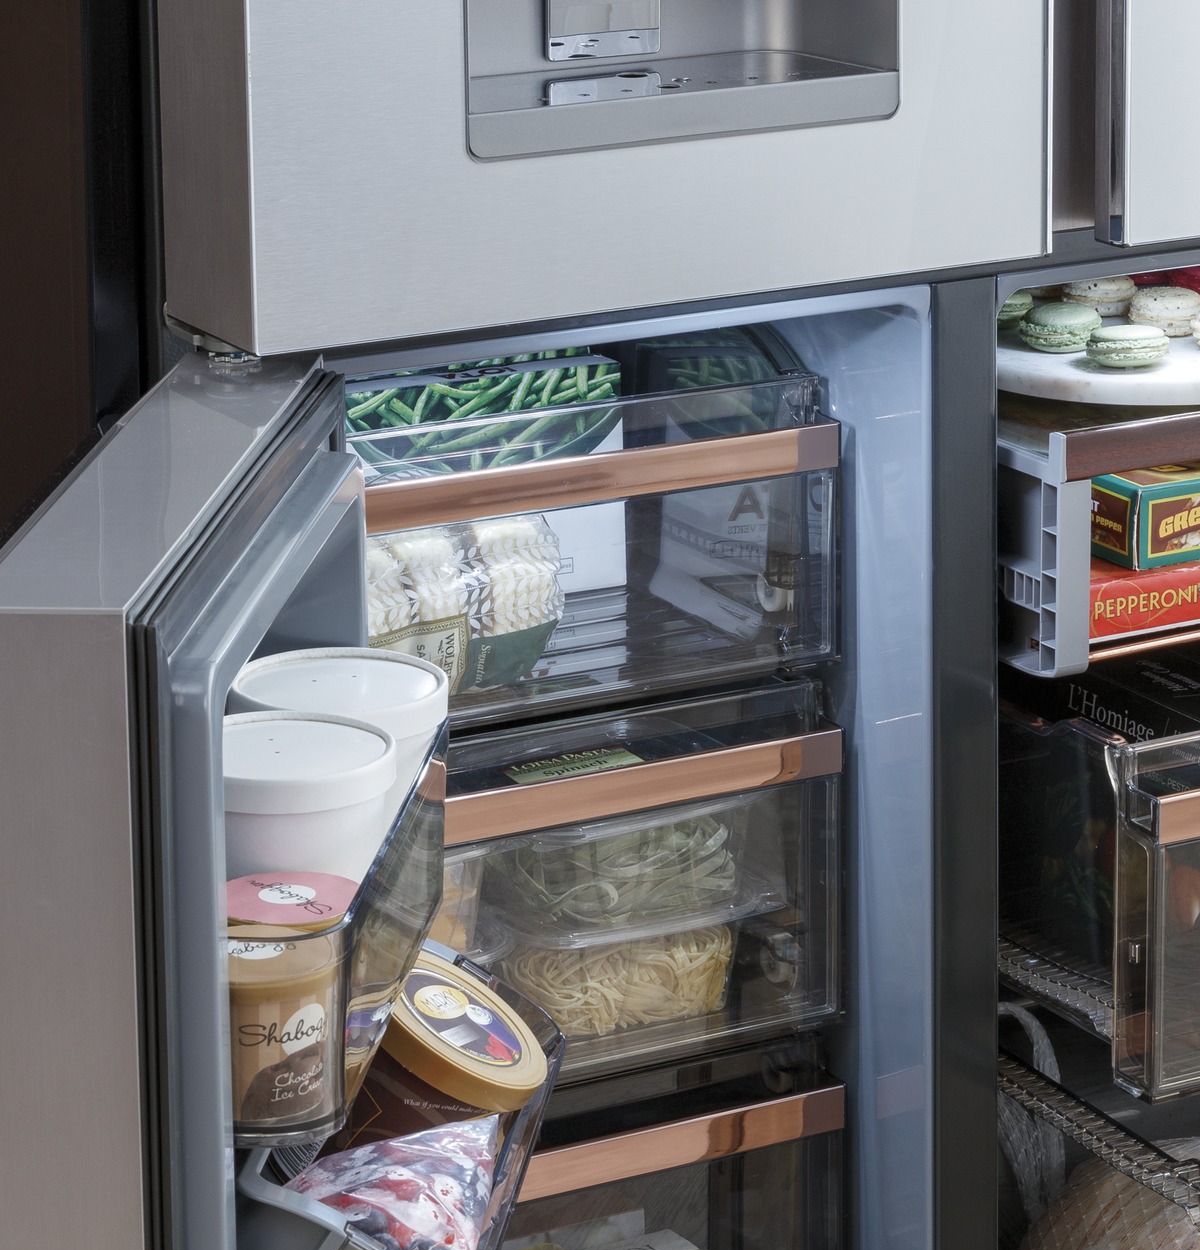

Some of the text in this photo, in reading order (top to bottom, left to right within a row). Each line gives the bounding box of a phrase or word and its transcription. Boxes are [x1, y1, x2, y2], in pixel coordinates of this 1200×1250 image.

[1094, 585, 1199, 620] PEPPERONI
[1067, 683, 1155, 744] L'Homiage
[543, 759, 609, 777] Spinach
[270, 1087, 295, 1102] Ice
[403, 1099, 421, 1107] What
